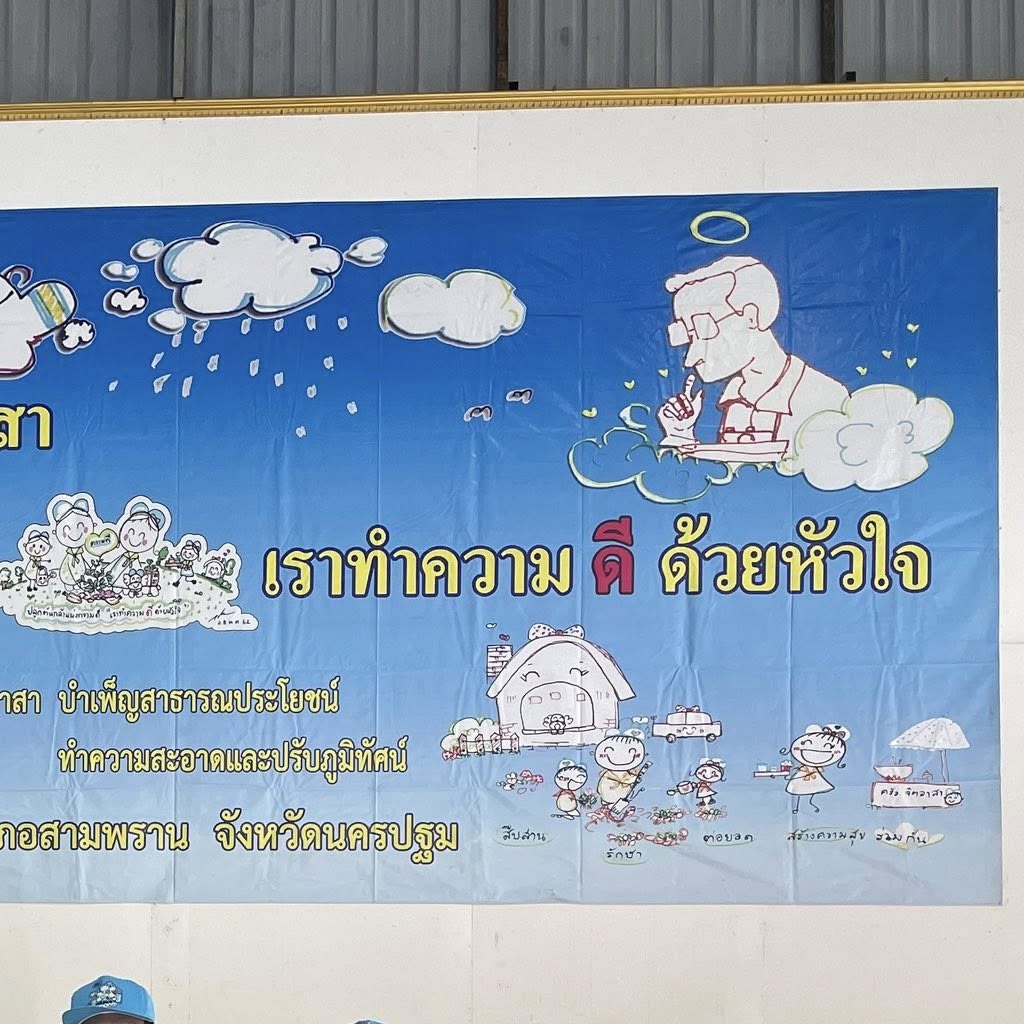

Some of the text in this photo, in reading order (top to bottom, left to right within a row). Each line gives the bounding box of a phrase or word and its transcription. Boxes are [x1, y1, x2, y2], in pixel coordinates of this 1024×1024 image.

[264, 511, 932, 597] เราทำความ ดี ด้วยหัวใจ
[58, 676, 340, 723] บำเพ็ญสาธารณประโยชน์
[57, 736, 409, 784] ทำความสะอาดและปรับภูมิทัศน์
[213, 807, 459, 864] จังหวัดนครปฐม
